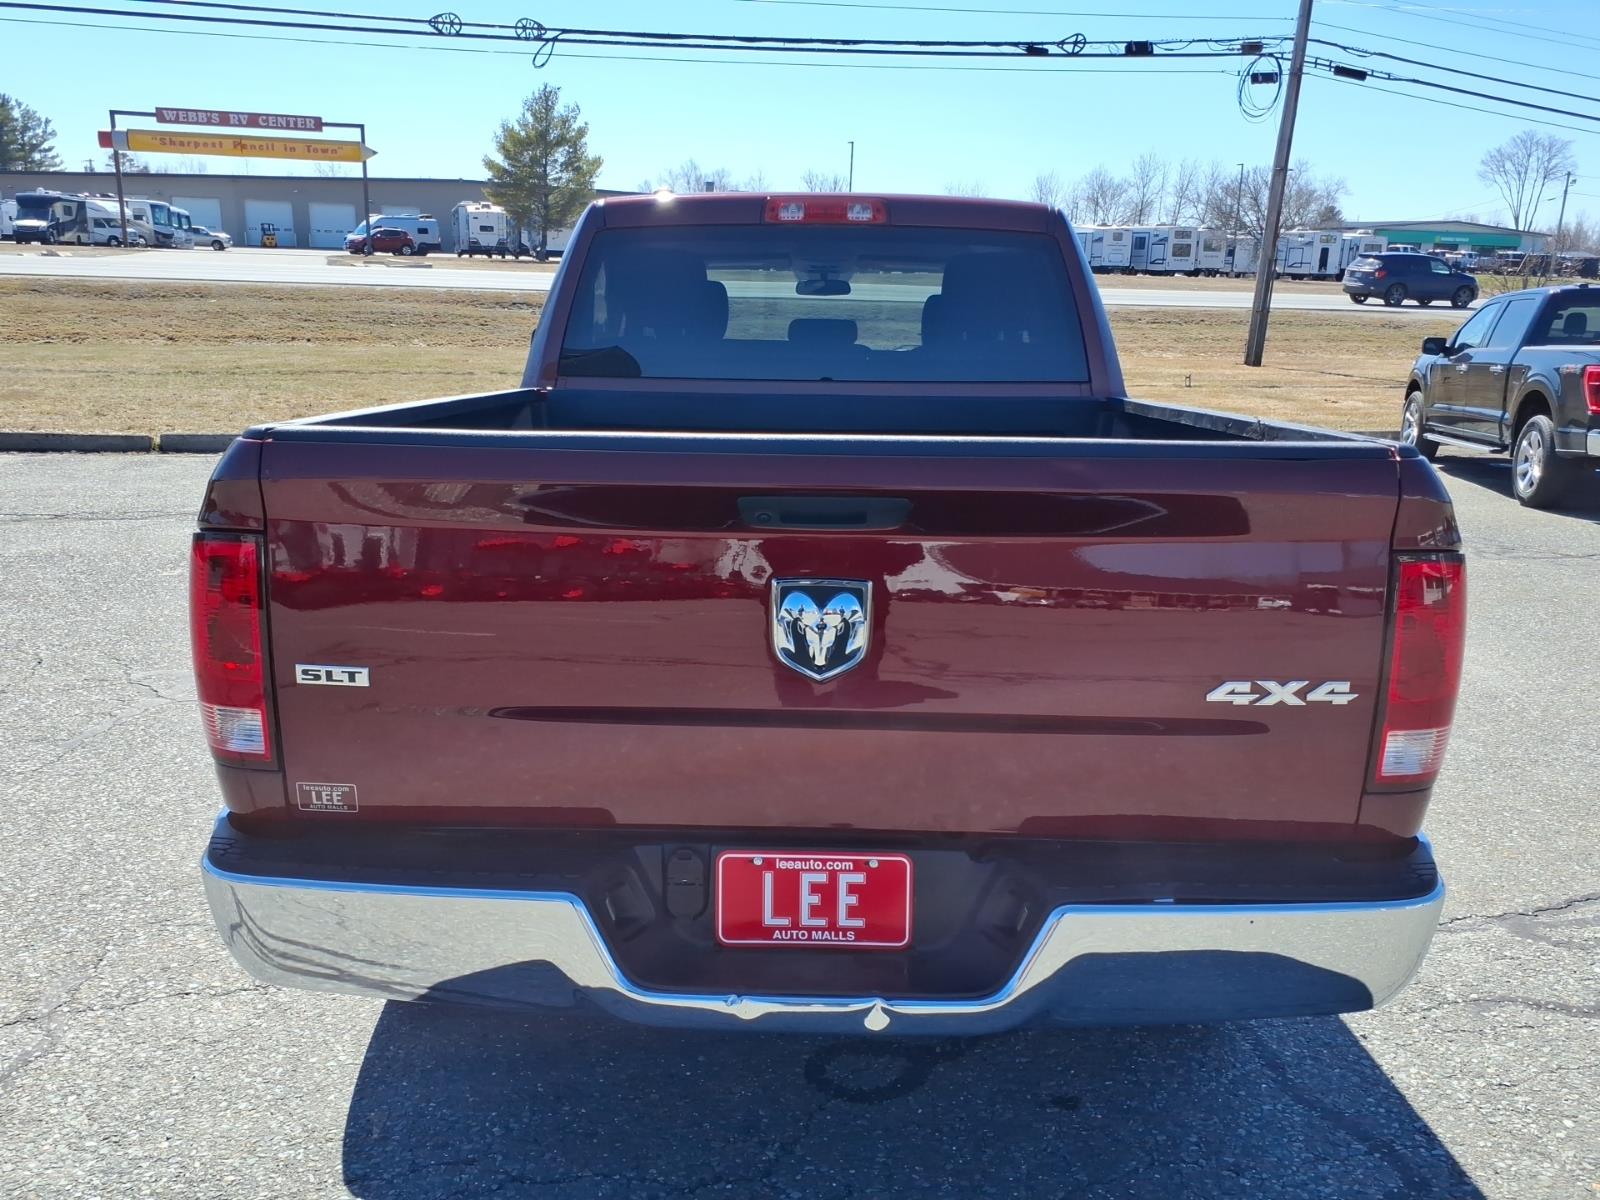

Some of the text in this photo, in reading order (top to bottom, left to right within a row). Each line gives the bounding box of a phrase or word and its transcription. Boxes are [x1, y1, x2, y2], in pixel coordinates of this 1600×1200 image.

[161, 110, 316, 129] WEBB'S RV CENTER
[232, 139, 275, 152] Pencil
[283, 143, 297, 153] in
[301, 668, 363, 684] SLT
[1206, 680, 1360, 706] 4X4
[303, 784, 350, 793] leeauto.com
[311, 790, 344, 805] LEE
[775, 858, 854, 871] leeauto.com
[762, 870, 867, 929] LEE
[772, 929, 856, 942] AUTO MALLS
